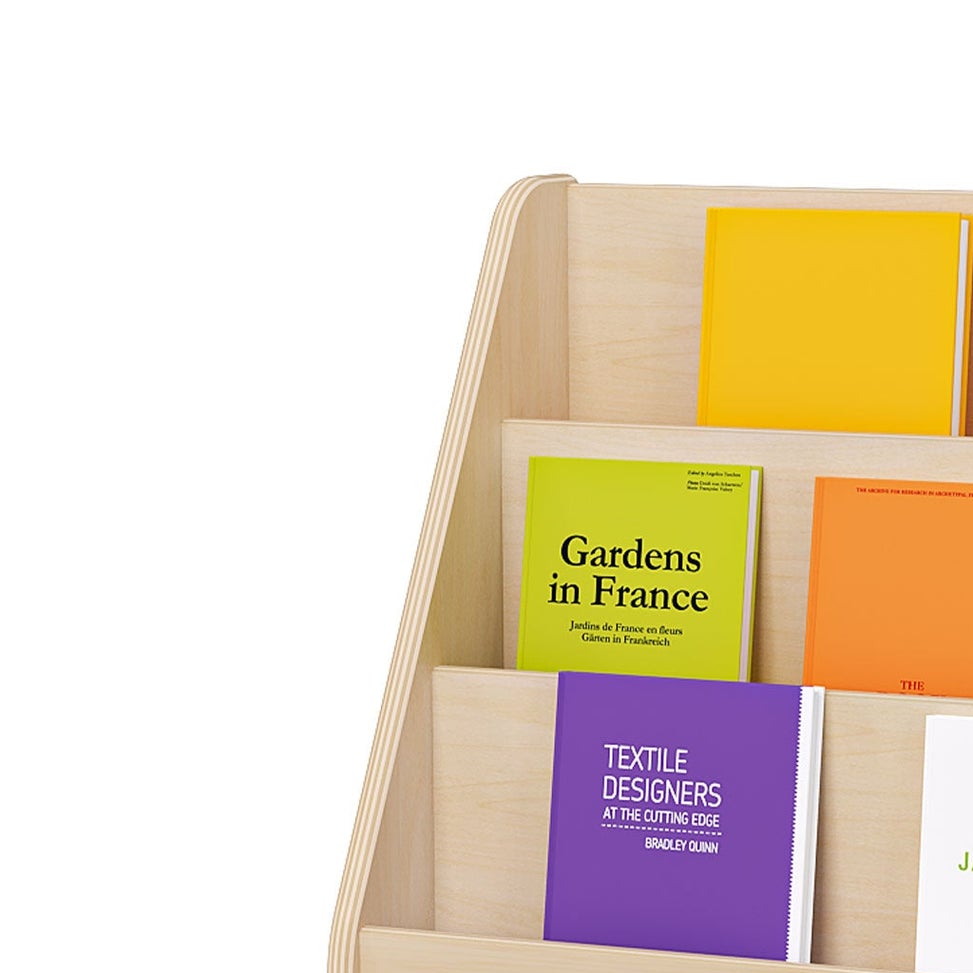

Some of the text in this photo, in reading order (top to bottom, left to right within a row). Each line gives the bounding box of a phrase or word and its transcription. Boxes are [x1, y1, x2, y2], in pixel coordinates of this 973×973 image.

[560, 535, 701, 572] Gardens
[548, 573, 709, 612] in France
[569, 620, 600, 631] Jardins
[602, 622, 613, 631] de
[615, 623, 644, 633] France
[659, 626, 683, 635] fleurs
[582, 633, 670, 646] Gärten in Frankreich
[900, 680, 924, 690] THE
[604, 744, 688, 773] TEXTILE
[603, 775, 721, 807] DESIGNERS
[603, 807, 720, 827] AT THE CUTTING EDGE
[645, 837, 718, 854] BRADLEY QUINN
